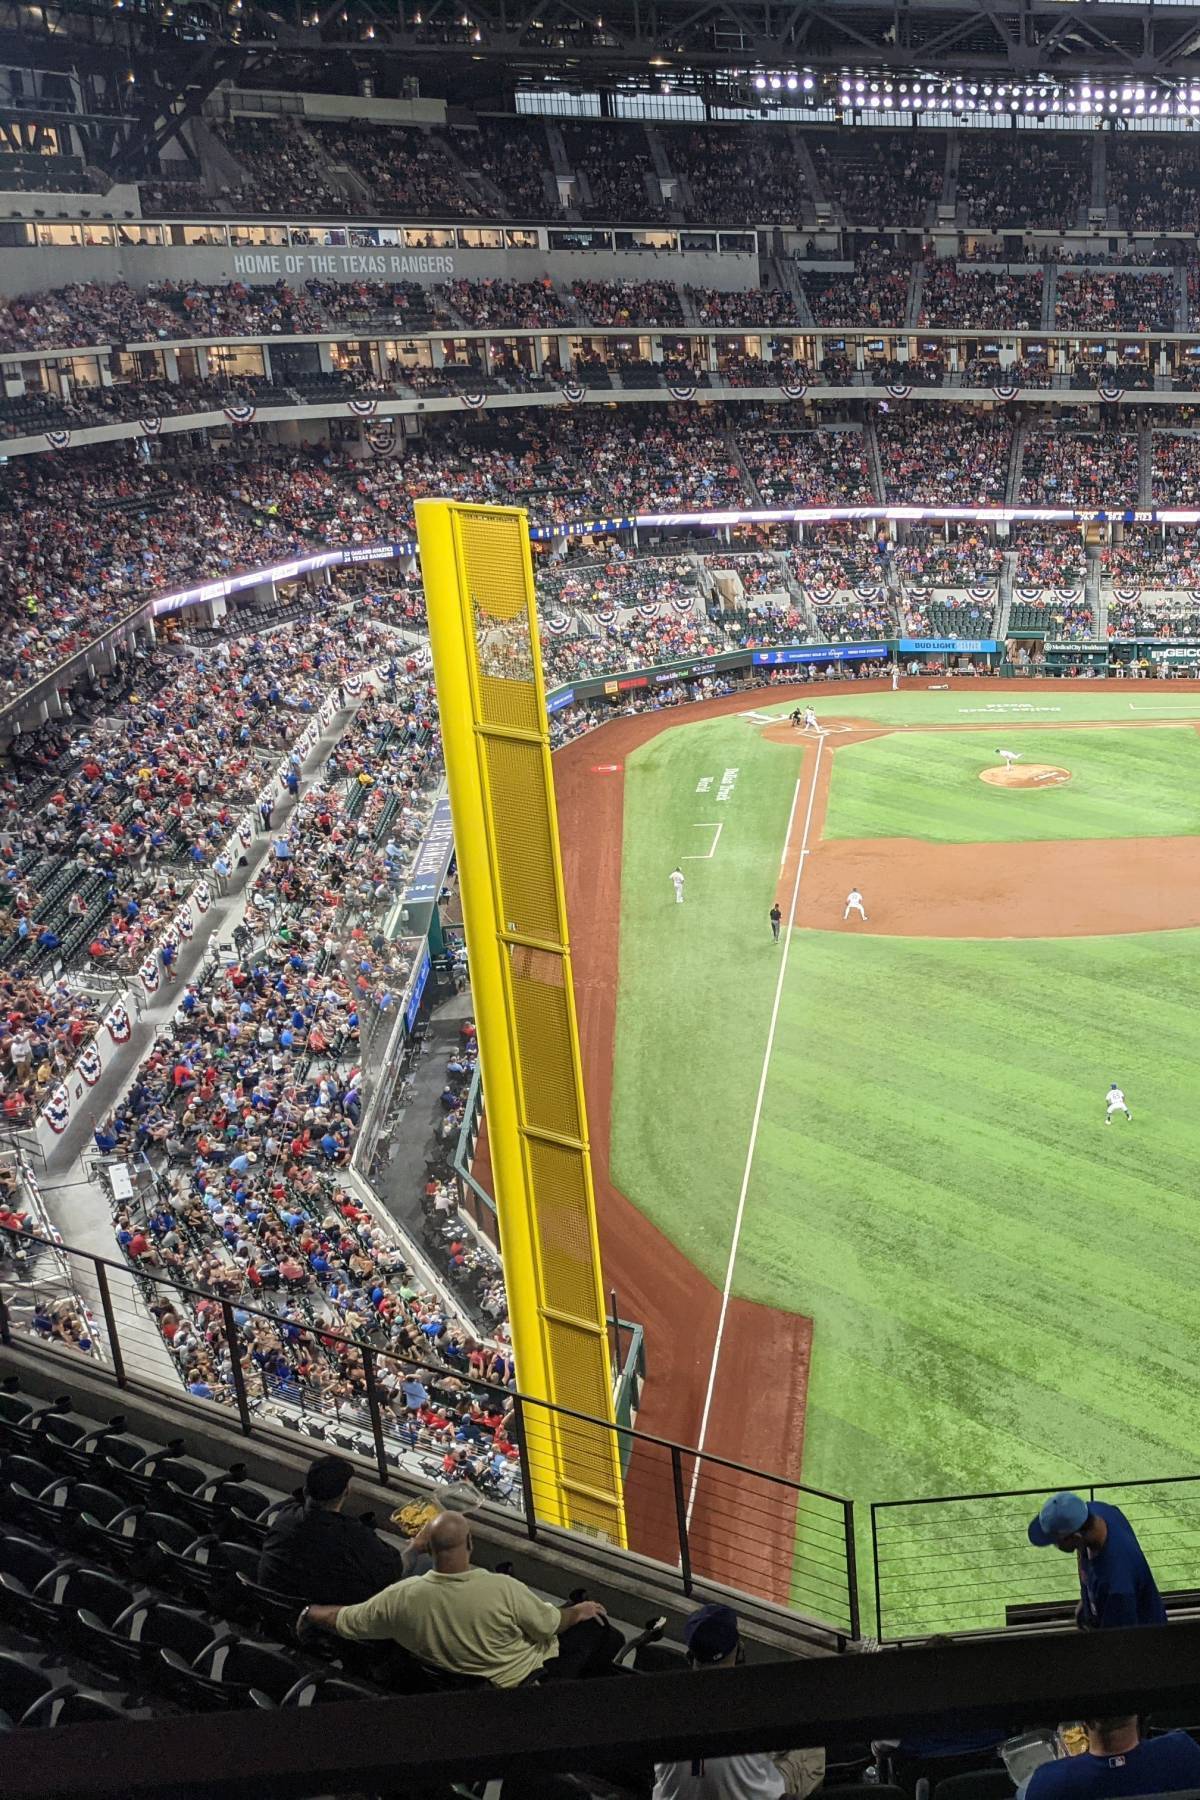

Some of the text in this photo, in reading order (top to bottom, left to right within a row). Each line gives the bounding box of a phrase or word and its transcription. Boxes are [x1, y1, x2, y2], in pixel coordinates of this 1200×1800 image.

[234, 255, 454, 274] HOME OF THE TEXAS RANGERS
[351, 548, 372, 556] OAKLAND
[352, 554, 368, 562] TEXAS
[416, 841, 450, 875] RANGERS
